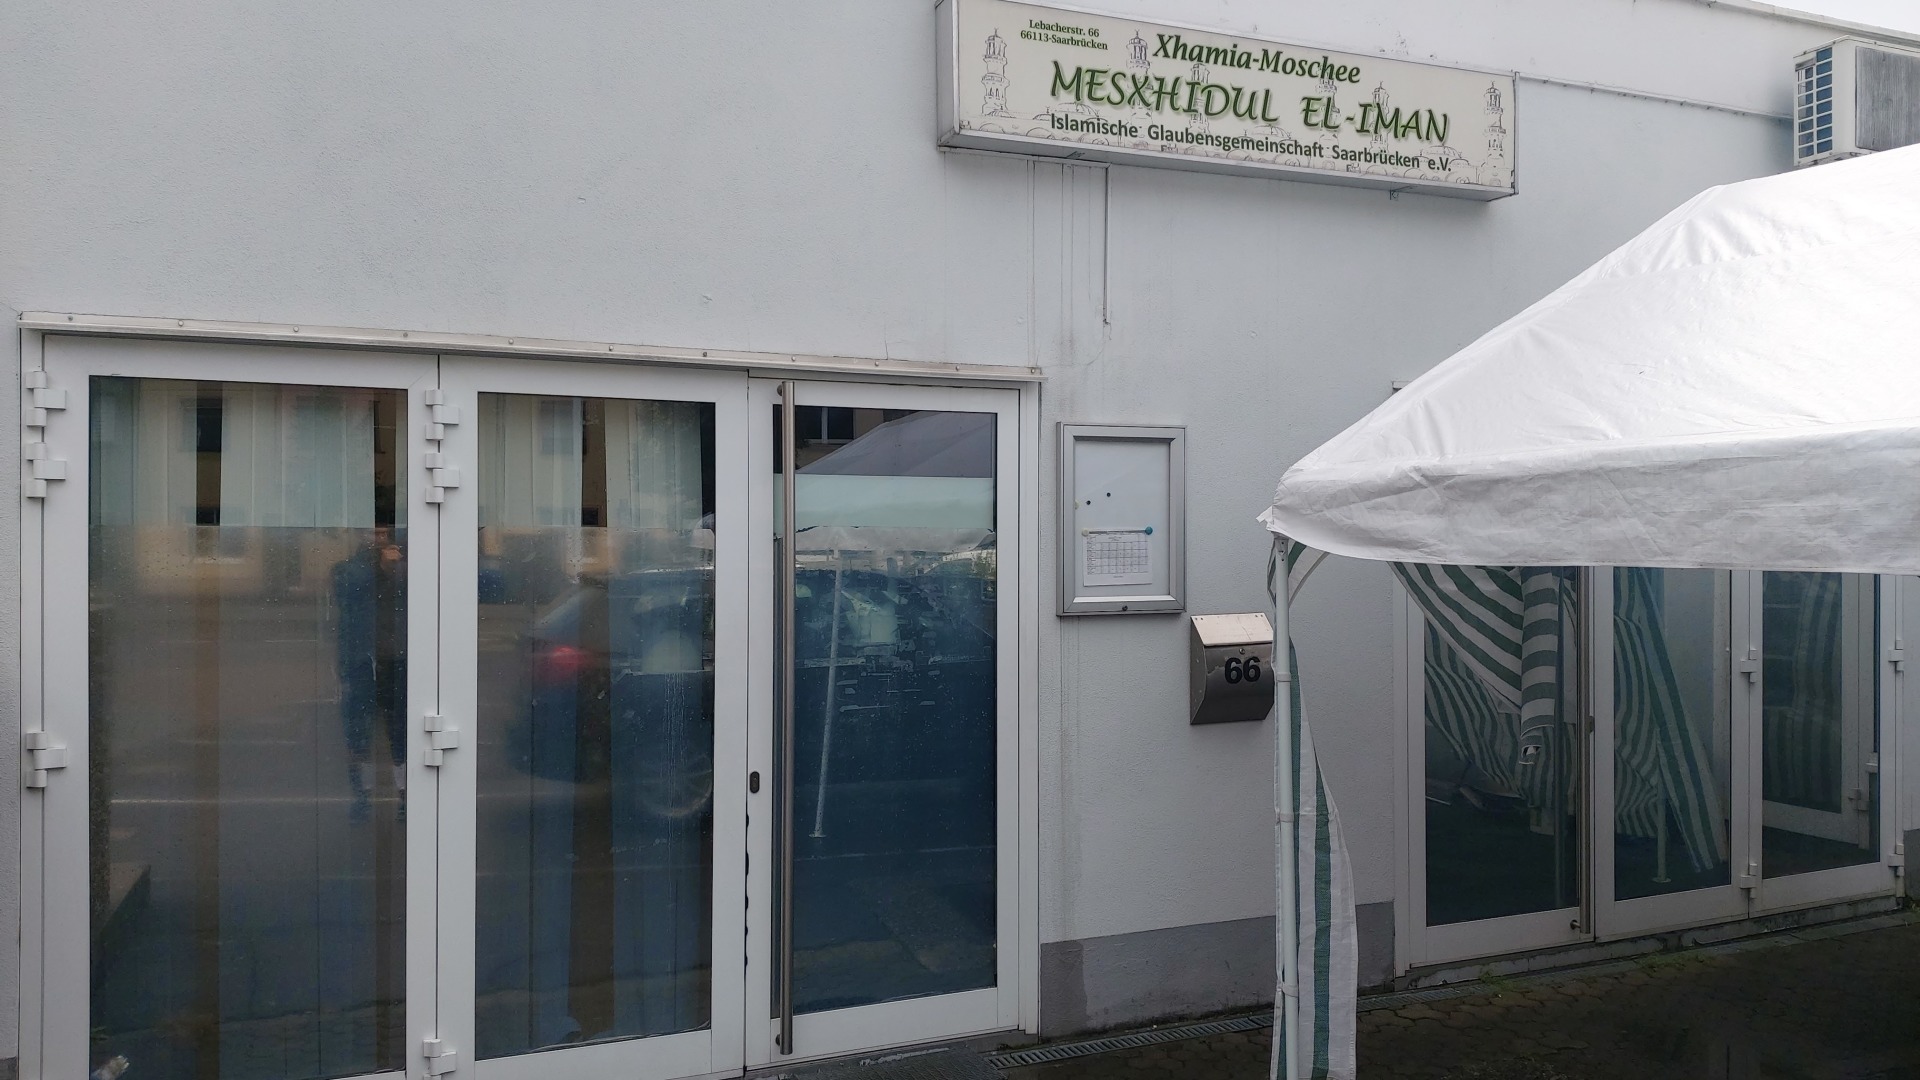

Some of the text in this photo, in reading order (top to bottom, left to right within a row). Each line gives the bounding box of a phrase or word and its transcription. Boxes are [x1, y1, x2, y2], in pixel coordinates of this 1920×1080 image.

[1020, 30, 1109, 51] 66113-Saarbrücken
[1029, 19, 1100, 38] Lebacherstr. 66
[1152, 33, 1361, 84] Xhamia-Moschee
[1050, 60, 1280, 123] MESXHIDUL
[1051, 113, 1452, 172] Islamische Glaubensgemeinschaft Saarbrücken e.V.
[1301, 95, 1449, 143] EL-IMAN
[1224, 656, 1262, 685] 66
